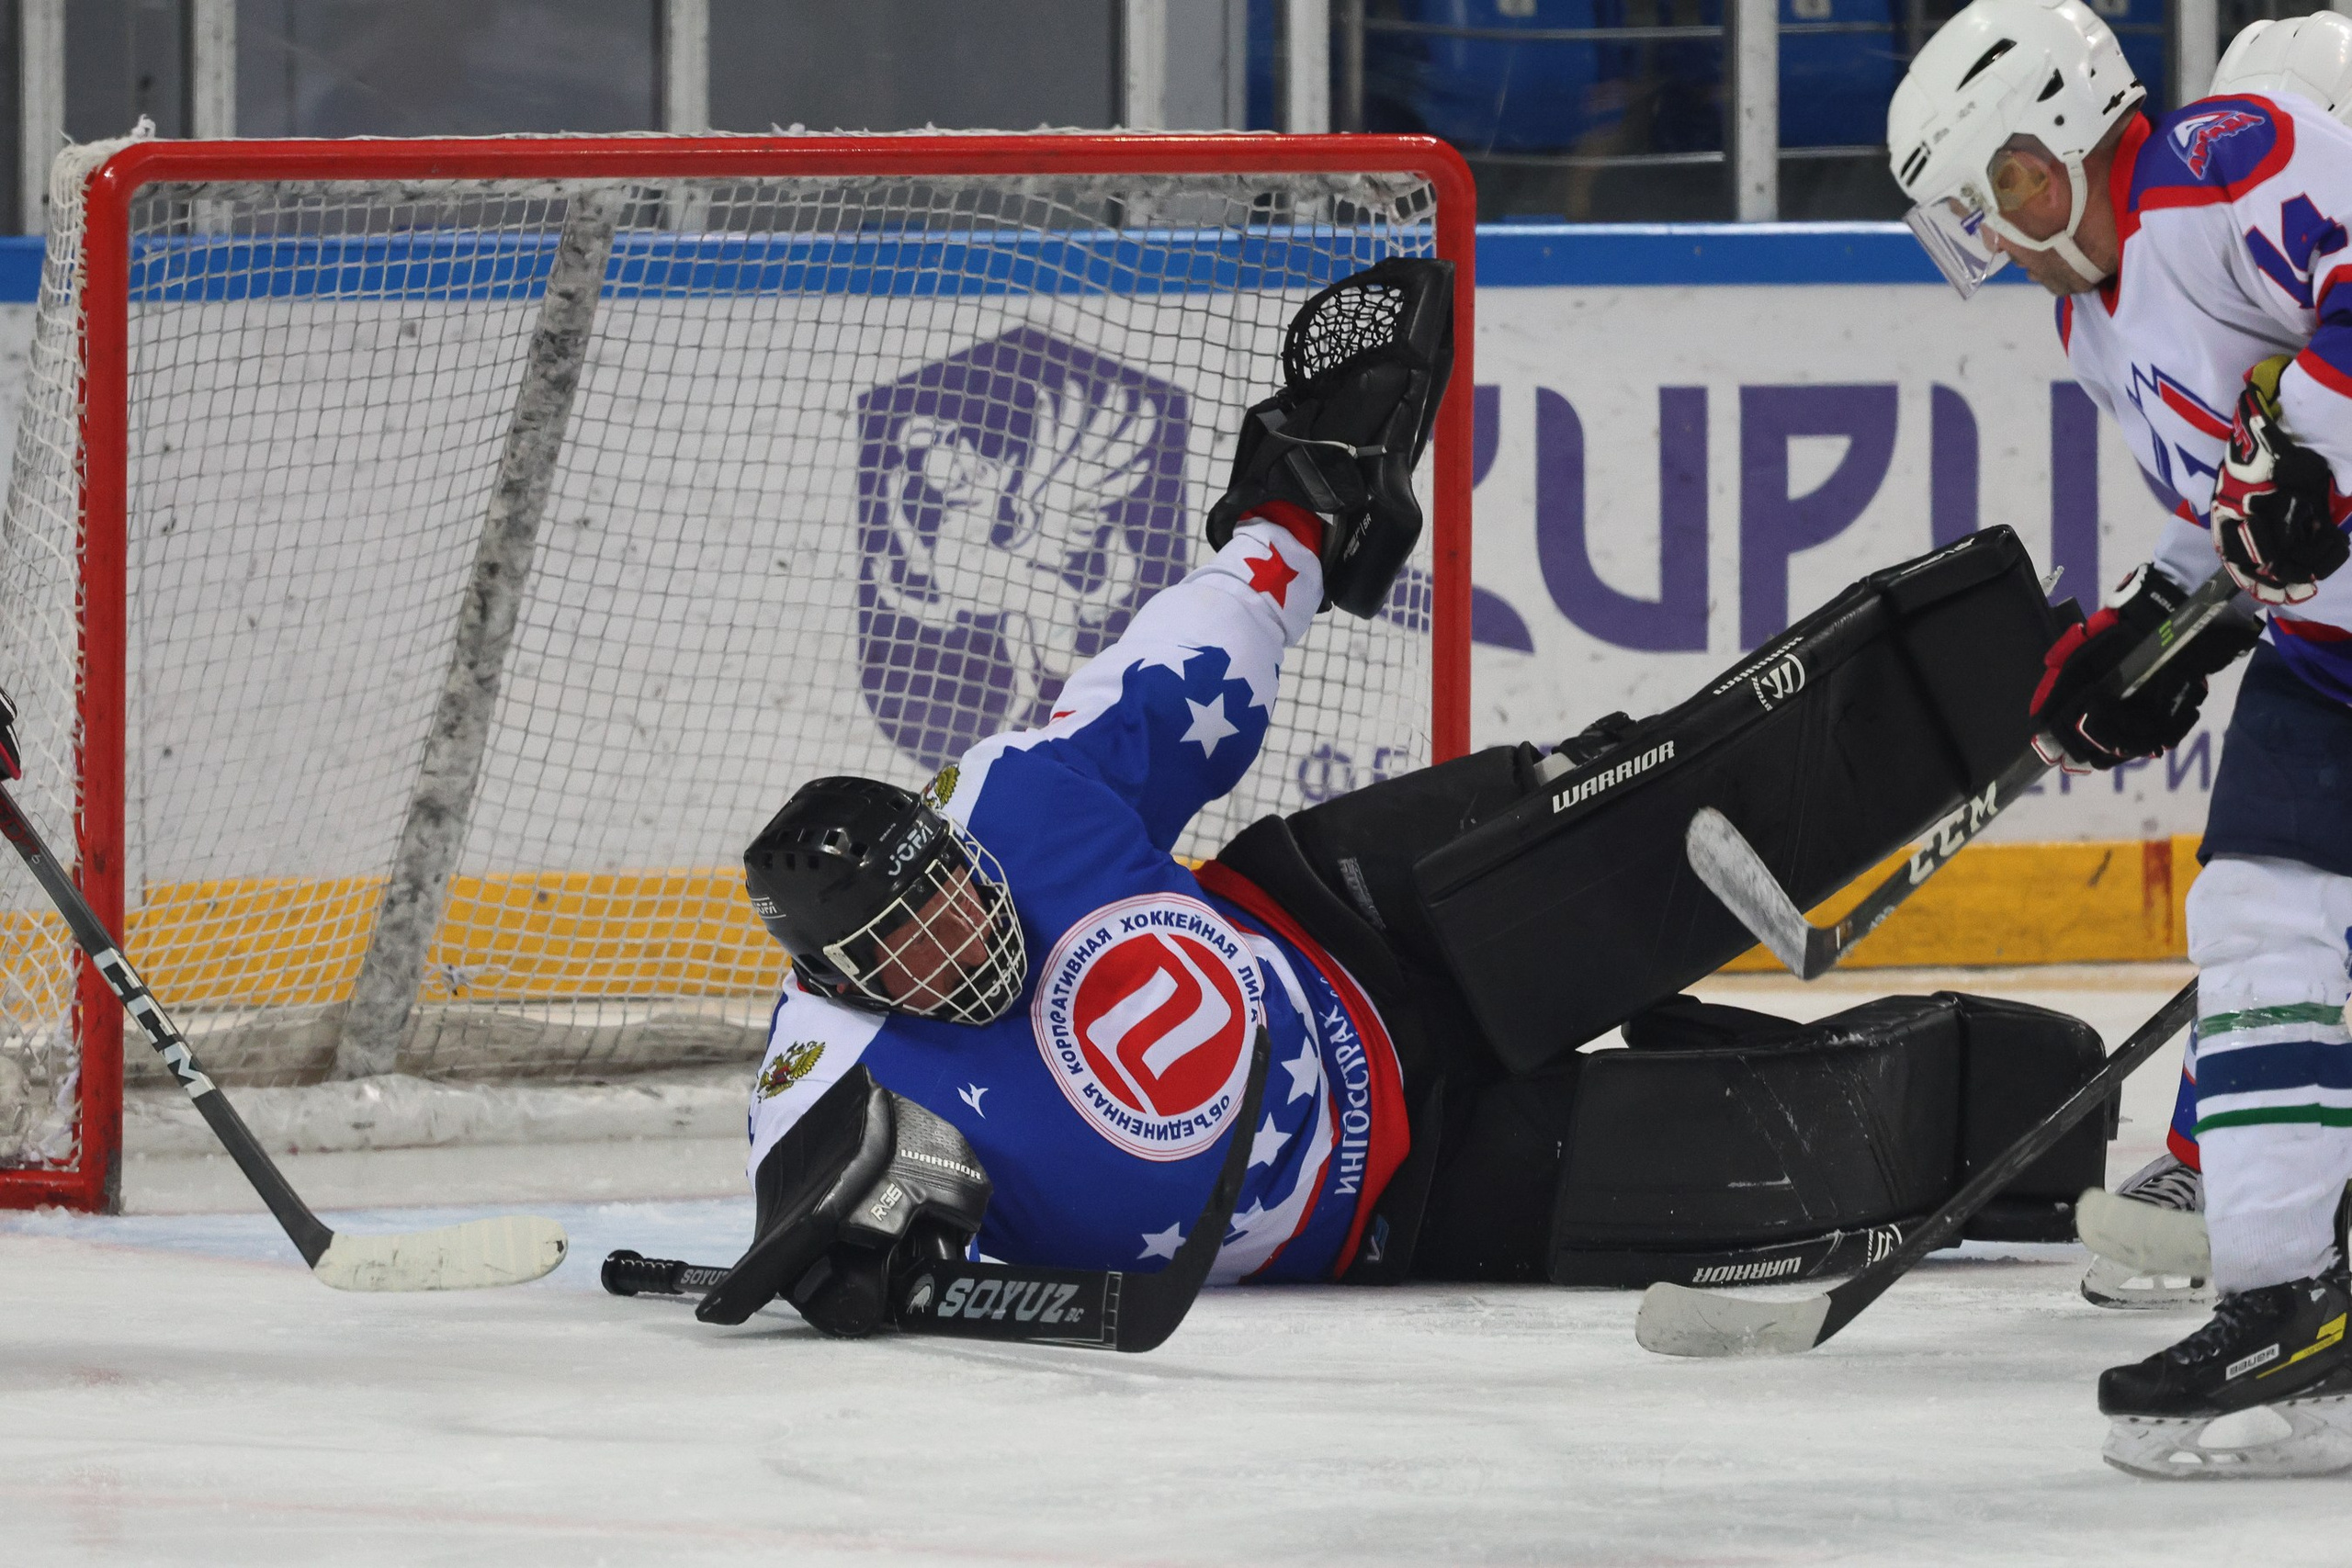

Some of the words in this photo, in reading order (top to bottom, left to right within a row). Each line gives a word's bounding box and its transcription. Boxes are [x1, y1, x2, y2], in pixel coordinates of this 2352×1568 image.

[2150, 592, 2175, 613] BAU
[1553, 740, 1675, 814] WARRIOR
[888, 820, 933, 876] JOFA
[1908, 781, 1999, 885] CCM
[1119, 910, 1238, 959] ХОККЕЙНАЯ
[1050, 927, 1113, 1076] КОРПРАТИВНАЯ
[1238, 965, 1261, 1022] ЛИГА
[93, 947, 217, 1099] CCM
[1082, 1082, 1230, 1141] ОБЪЕДИНЕННАЯ
[1319, 1005, 1371, 1195] ИНГОССТРАХ
[900, 1149, 981, 1179] WARRIOR
[1692, 1256, 1802, 1283] WARRIOR
[937, 1278, 1080, 1323] SOYUZ
[2229, 1348, 2276, 1376] BAUER
